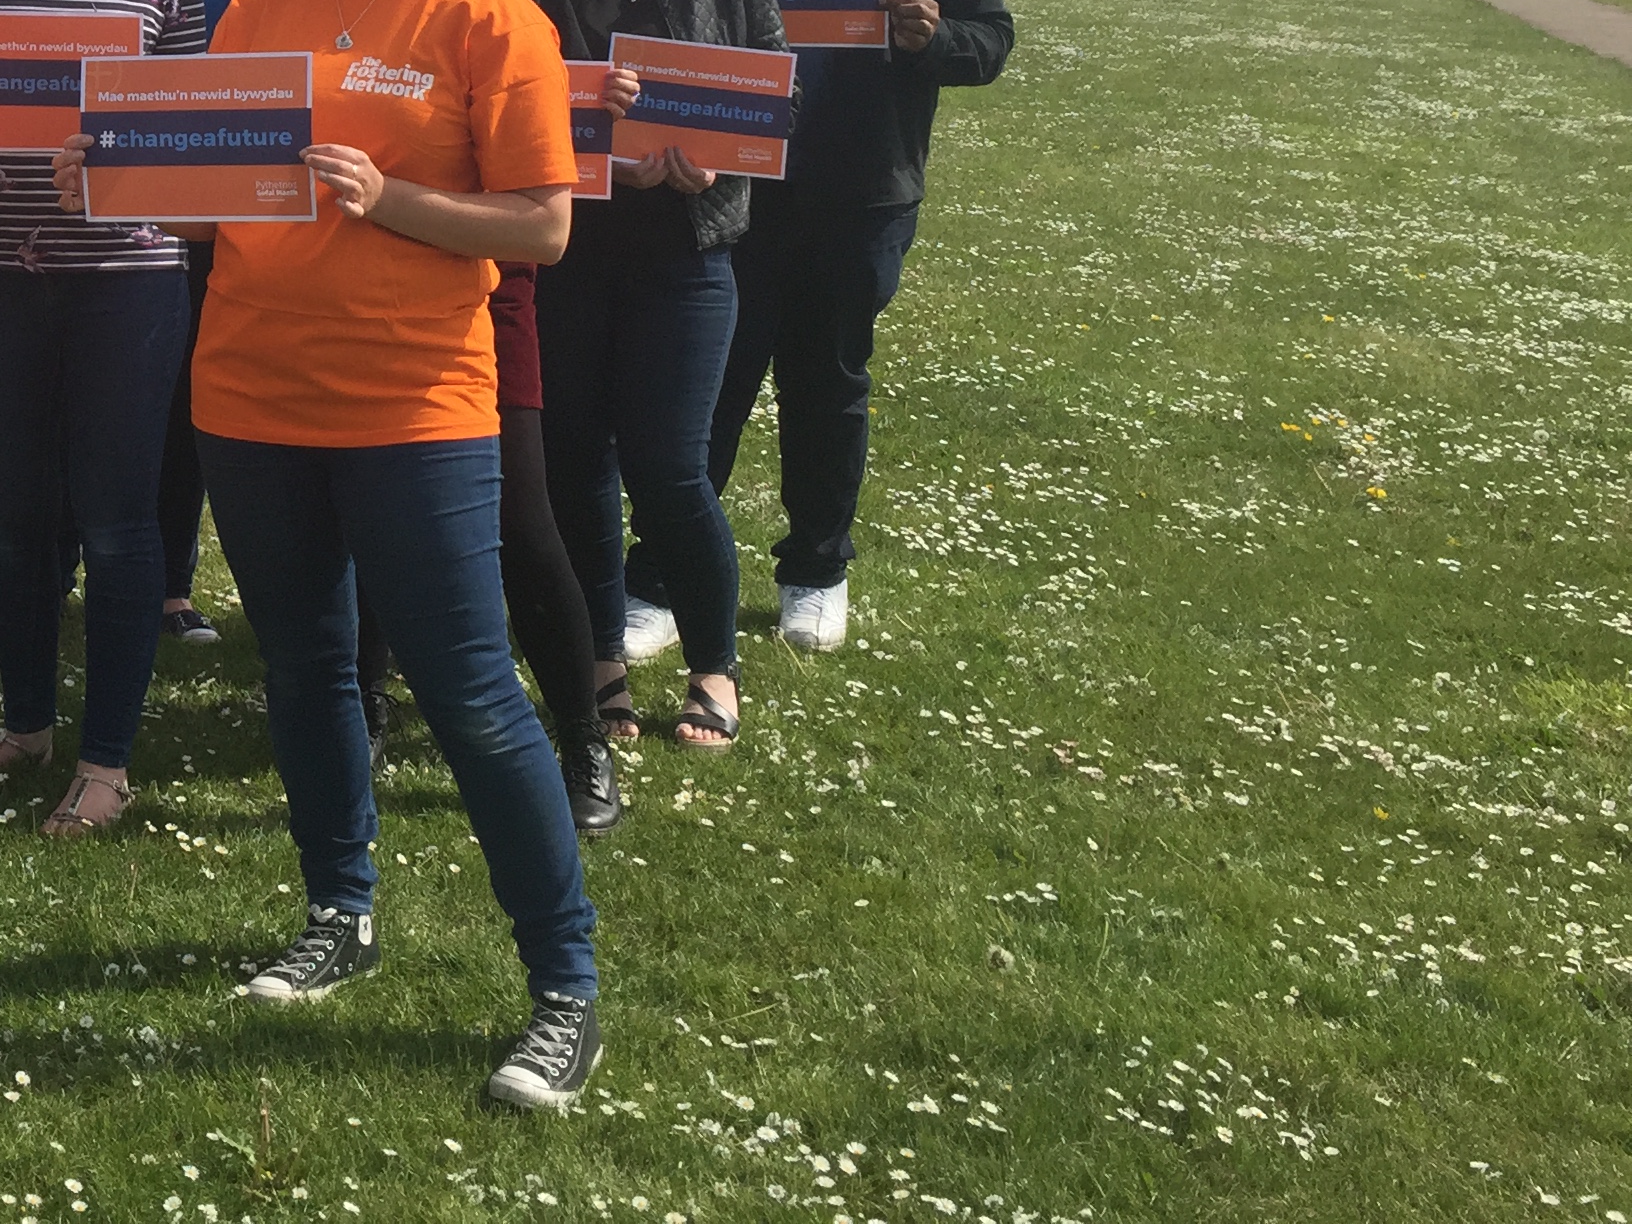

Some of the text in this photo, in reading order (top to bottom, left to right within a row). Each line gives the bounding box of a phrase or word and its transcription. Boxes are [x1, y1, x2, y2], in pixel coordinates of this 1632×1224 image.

[39, 42, 74, 52] newid
[76, 43, 128, 55] bywydau
[362, 56, 382, 66] The
[346, 62, 435, 89] Fostering
[731, 74, 779, 88] bywydau
[98, 88, 293, 102] Mae maethu'n newid bywydau
[340, 76, 425, 101] Network
[634, 93, 774, 124] changeafuture
[99, 127, 293, 152] #changeafuture
